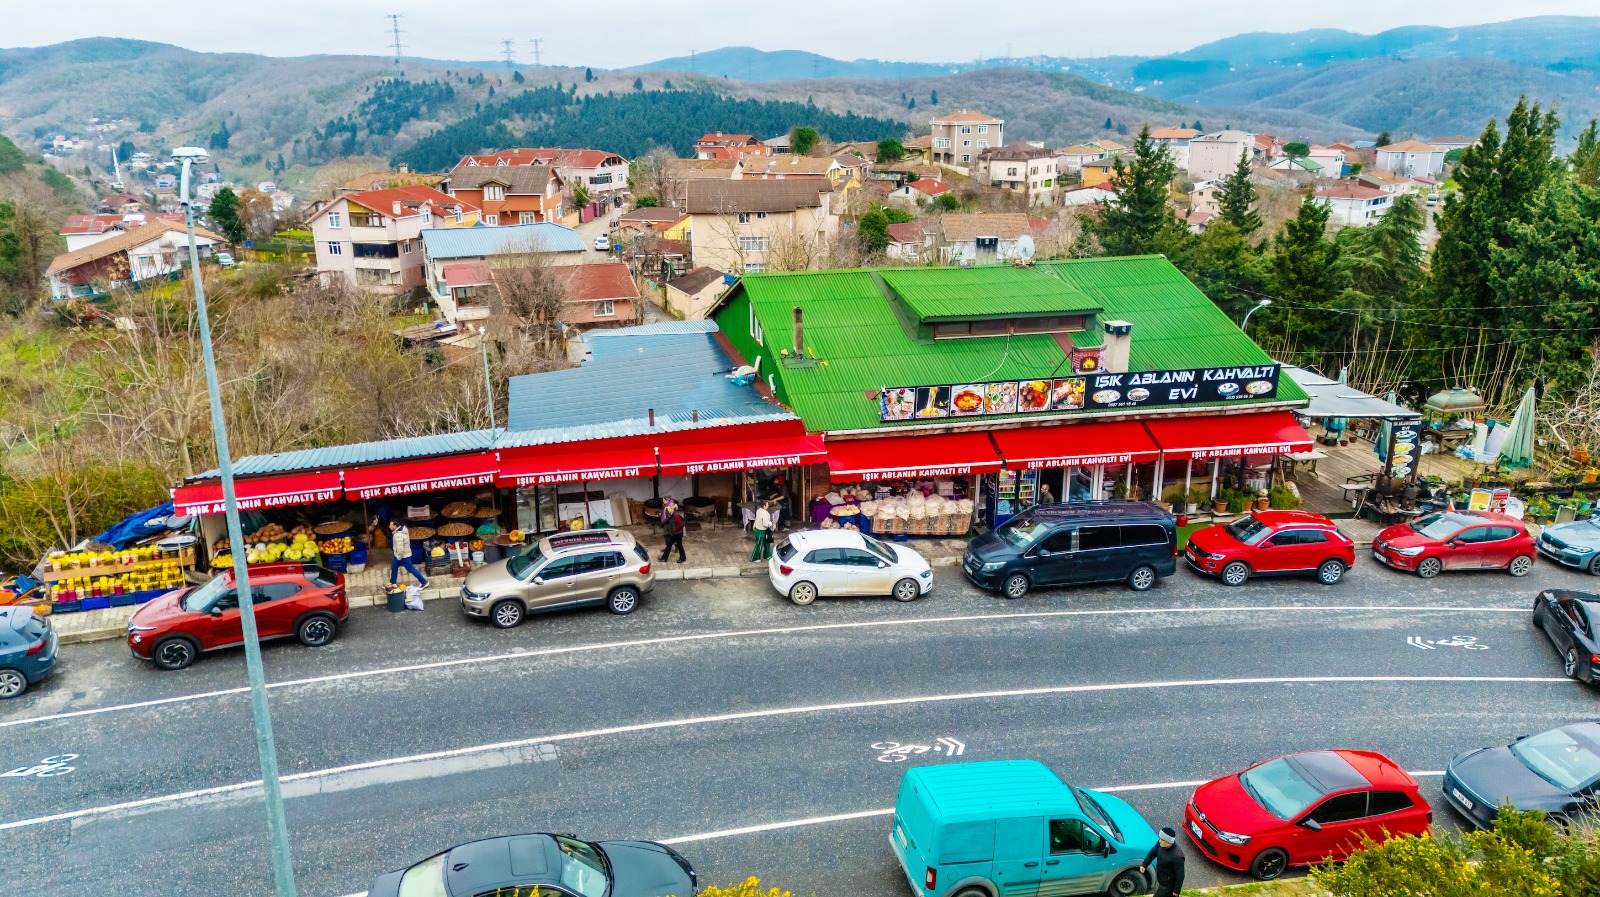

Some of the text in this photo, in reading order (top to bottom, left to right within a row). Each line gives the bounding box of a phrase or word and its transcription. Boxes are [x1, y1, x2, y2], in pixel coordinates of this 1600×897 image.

[1095, 366, 1275, 388] IŞIK ABLANIN KAHVALTI
[1168, 384, 1198, 400] EVİ
[1027, 454, 1131, 470] IŞIK ABLANIN KAHVALTI EVİ
[1191, 445, 1291, 460] IŞIK ABLANIN KAHVALTI EVİ
[687, 455, 800, 474] IŞIK ABLANIN KAHVALTI EVİ
[863, 466, 970, 481] IŞIK ABLANIN KAHVALTI EVİ
[360, 473, 494, 499] IŞIK ABLANIN KAHVALTI EVİ
[517, 468, 639, 487] IŞIK ABLANIN KAHVALTI EVİ
[186, 489, 334, 516] IŞIK ABANIN KAHVALTI EVİ
